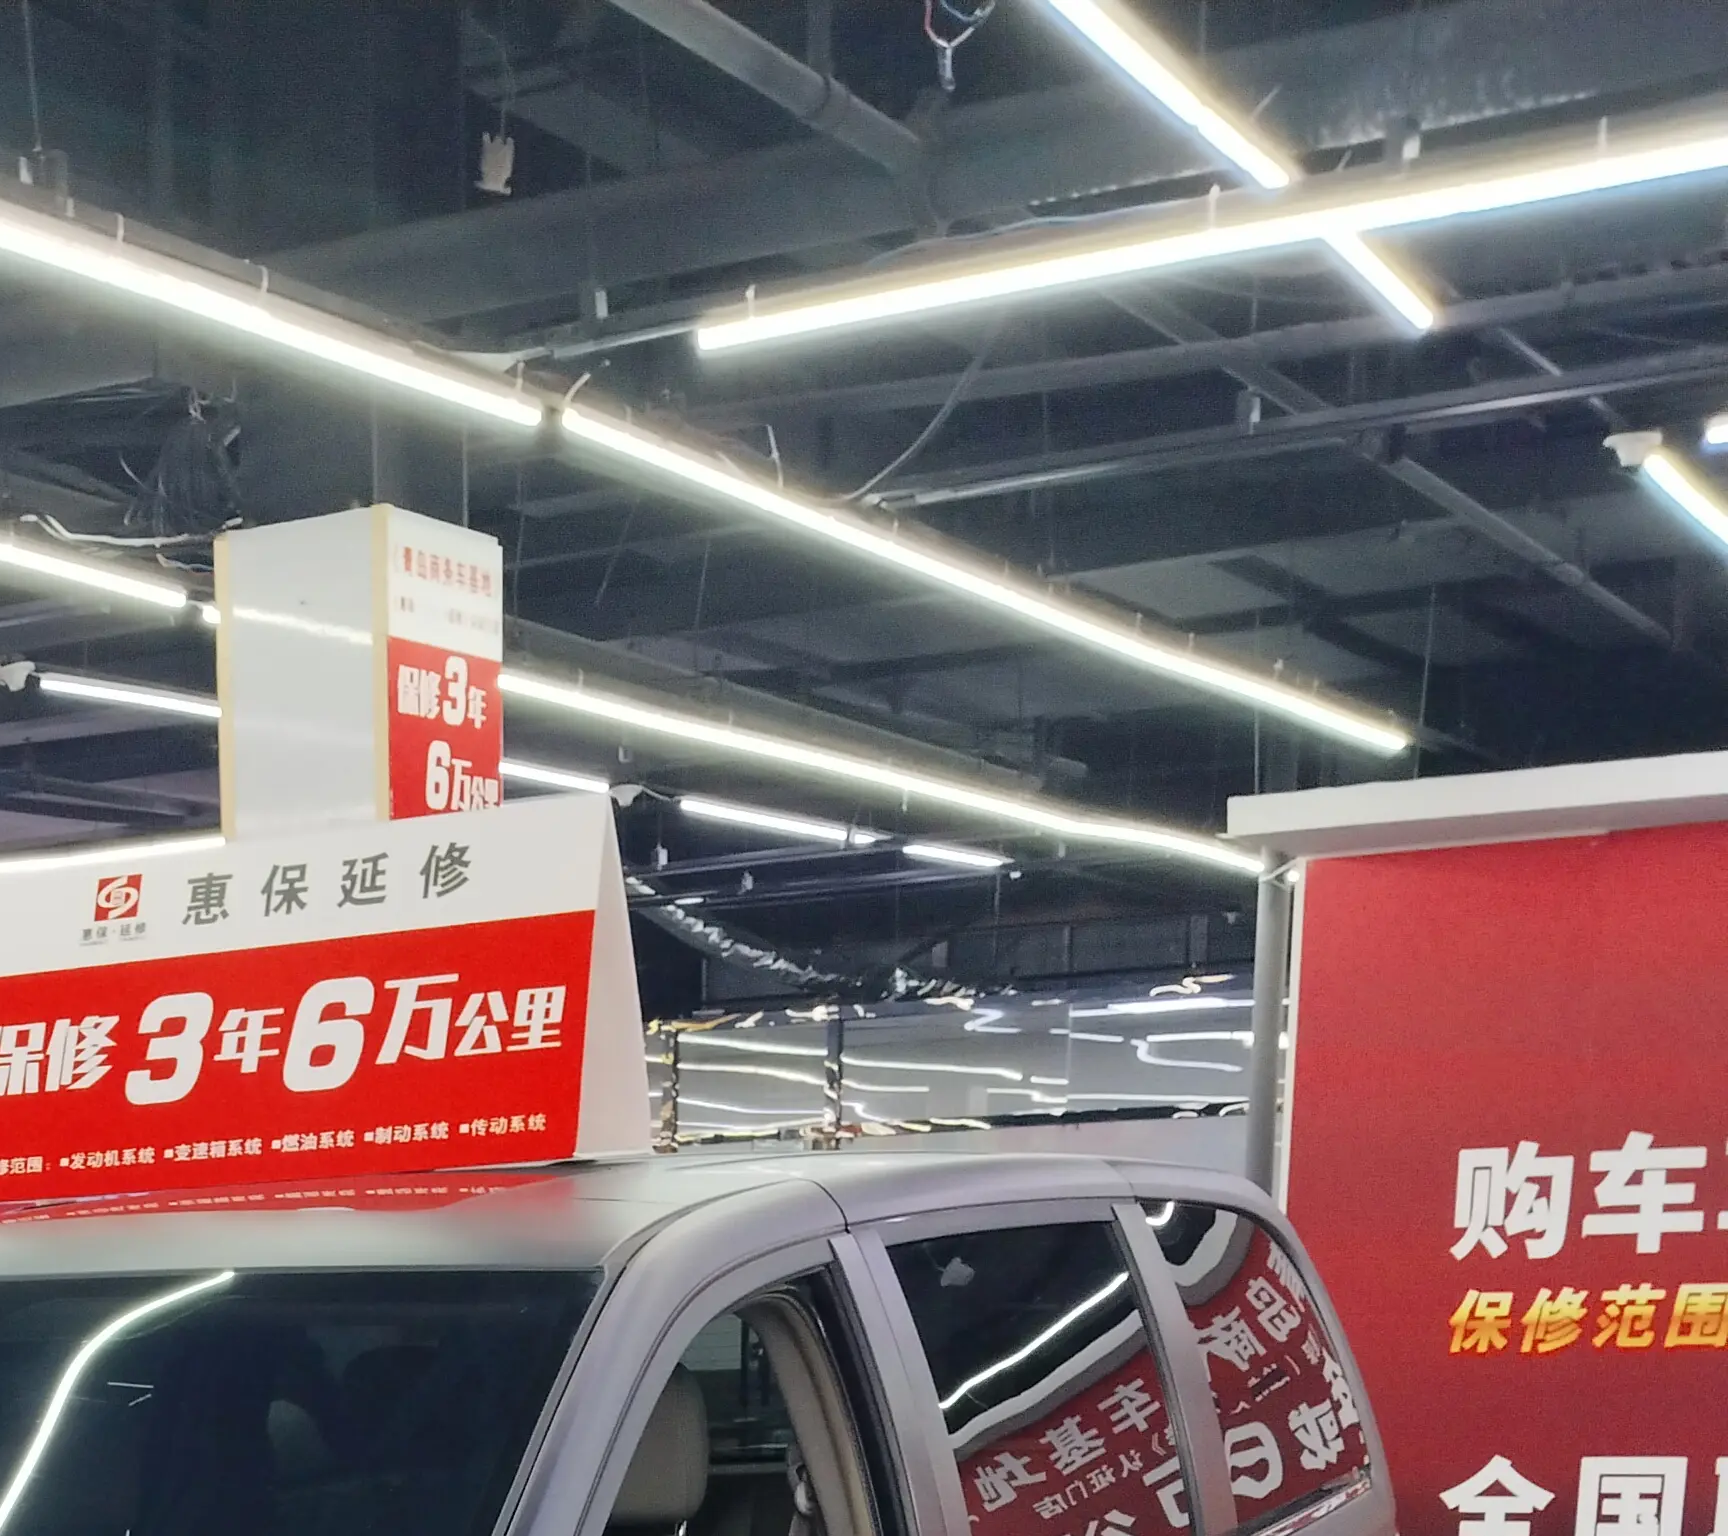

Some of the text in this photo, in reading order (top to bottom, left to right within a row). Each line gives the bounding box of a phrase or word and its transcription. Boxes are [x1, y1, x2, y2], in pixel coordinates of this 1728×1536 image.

[398, 656, 487, 729] 保修3年
[182, 842, 471, 926] 惠保延修
[1448, 1130, 1728, 1261] 购车
